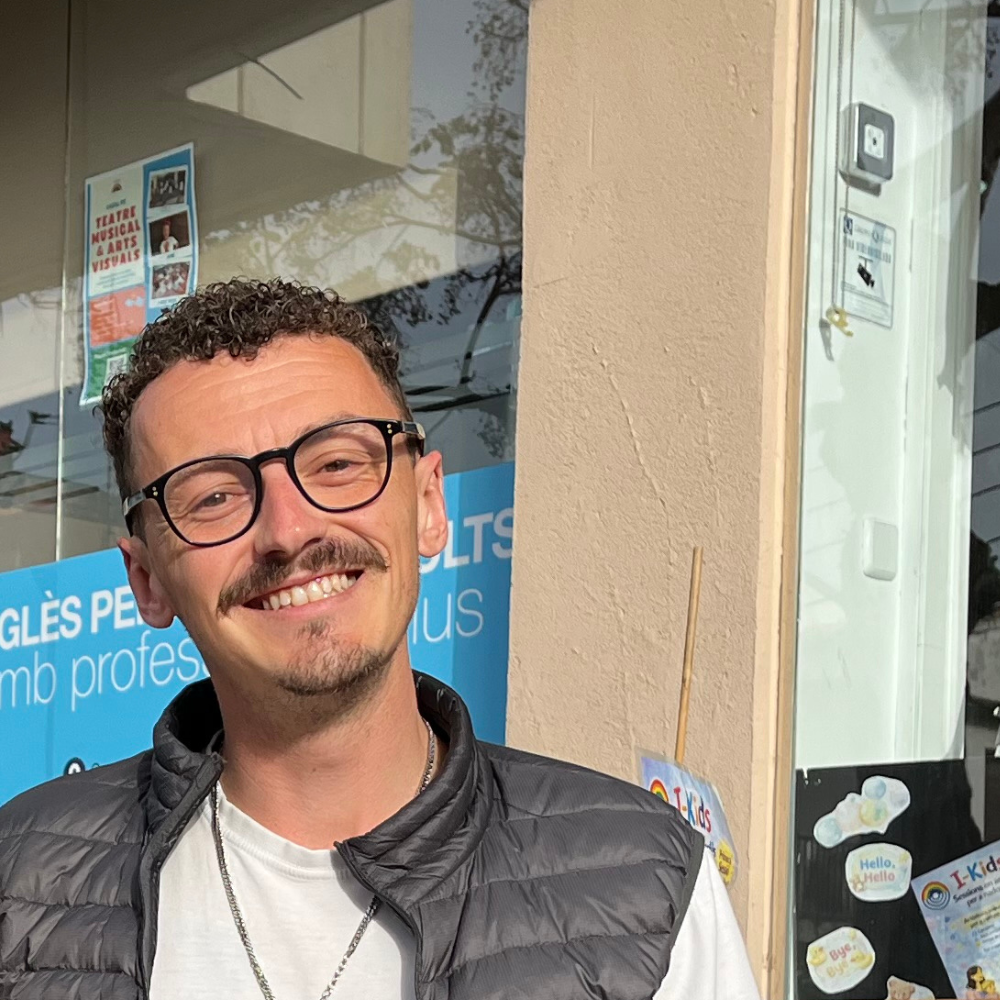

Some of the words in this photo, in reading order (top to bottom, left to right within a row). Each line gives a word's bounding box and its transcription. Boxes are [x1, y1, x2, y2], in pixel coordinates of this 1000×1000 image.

[96, 205, 136, 229] TEATRE
[91, 219, 141, 245] MUSICAL
[107, 235, 138, 255] ARTS
[92, 249, 140, 273] VISUALS
[91, 584, 144, 634] PE
[419, 507, 514, 575] LTS
[70, 630, 211, 712] profes
[673, 786, 712, 833] I-Kids
[864, 871, 895, 883] Hello
[826, 961, 849, 978] Bye
